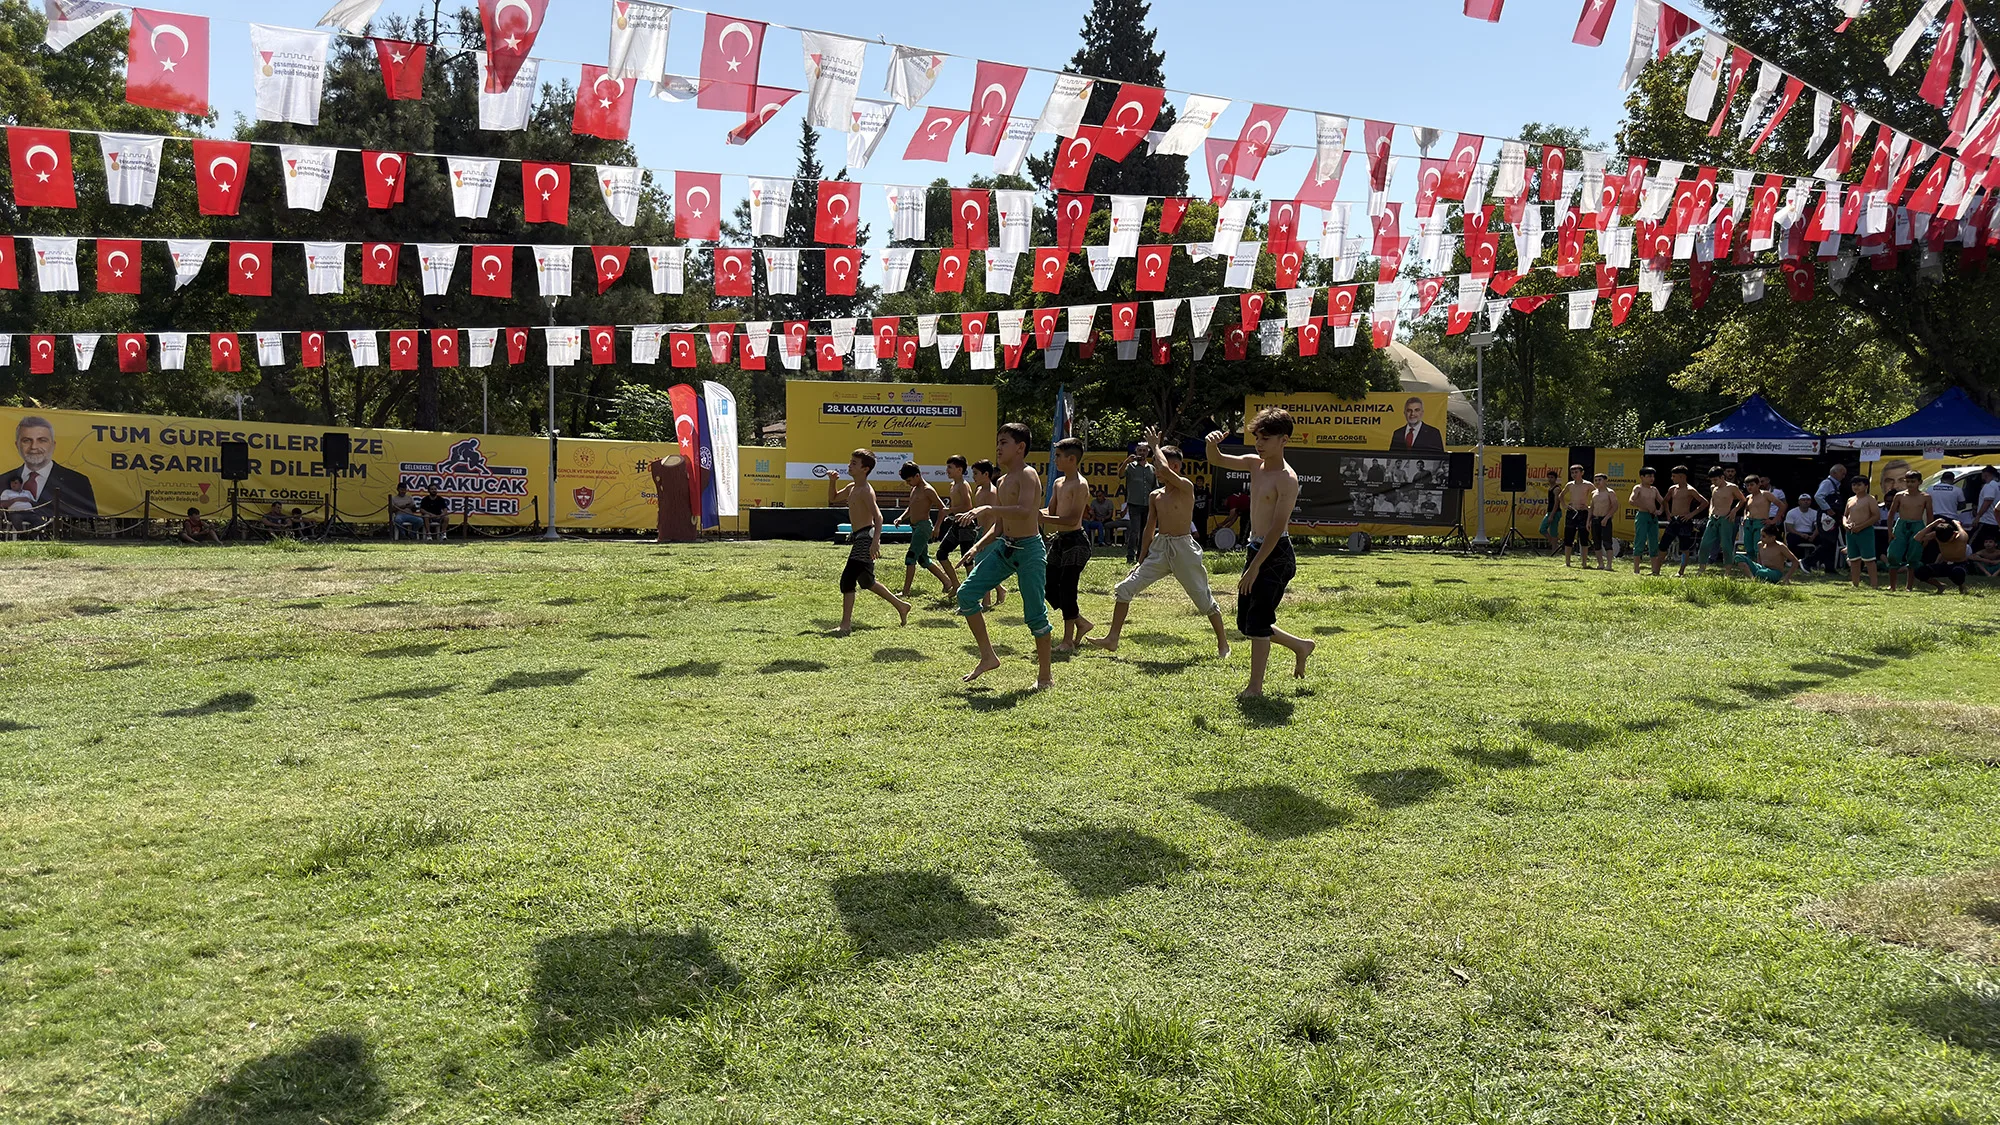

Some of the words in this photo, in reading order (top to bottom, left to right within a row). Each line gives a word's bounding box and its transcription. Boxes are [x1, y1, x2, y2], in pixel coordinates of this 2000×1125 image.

[843, 405, 904, 414] KARAKUCAK
[883, 416, 932, 430] Geldiniz
[1334, 416, 1381, 425] DİLERİM
[91, 425, 150, 444] TÜM
[1727, 441, 1755, 451] Büyükşehir
[1756, 442, 1783, 451] Belediyesi
[400, 474, 527, 495] KARAKUCAK
[270, 487, 324, 500] GÖRGEL
